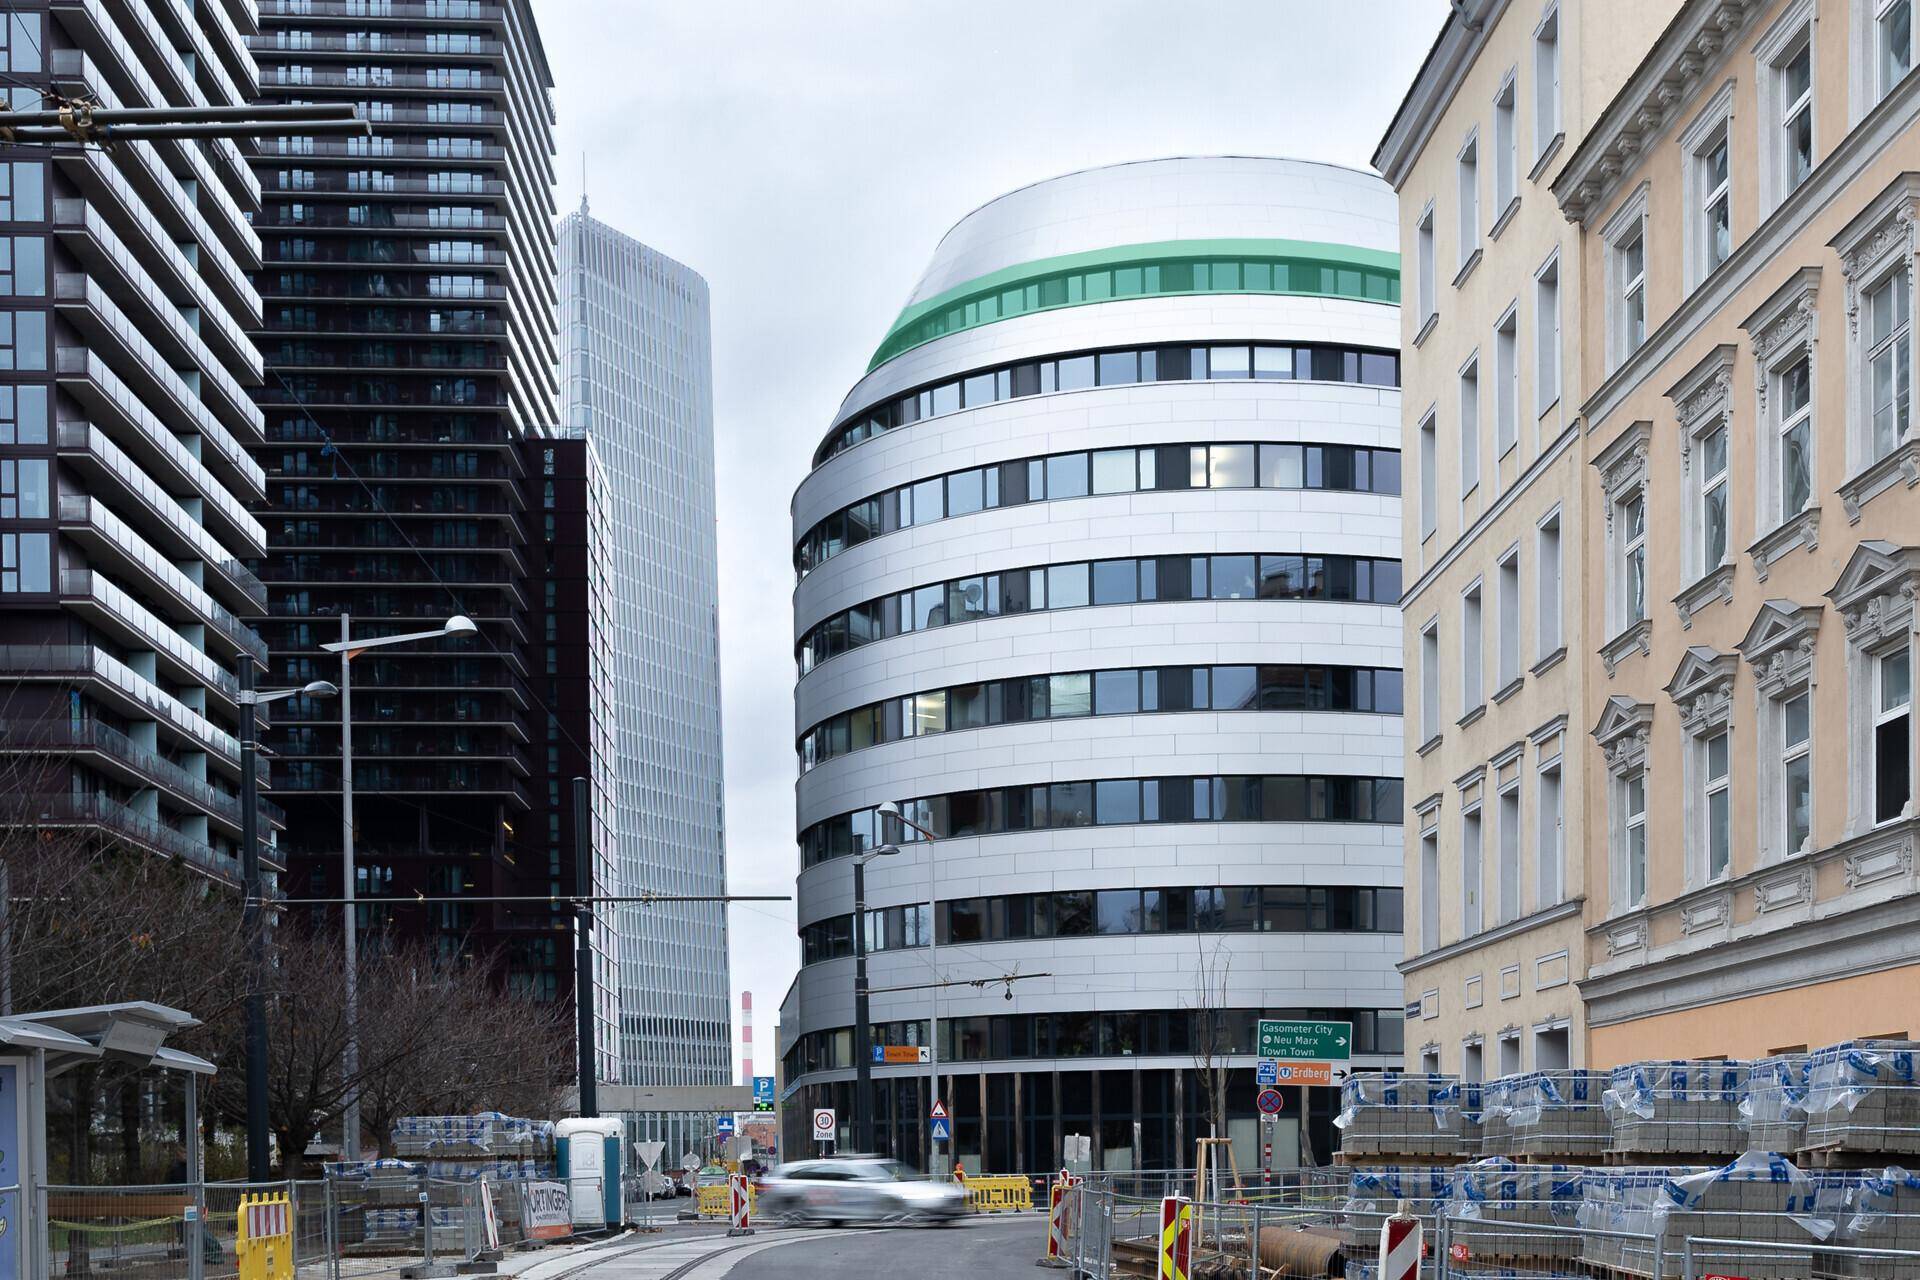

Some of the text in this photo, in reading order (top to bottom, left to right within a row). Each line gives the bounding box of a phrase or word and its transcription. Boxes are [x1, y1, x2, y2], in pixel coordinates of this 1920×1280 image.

[1262, 1024, 1333, 1035] Gasometer City
[1274, 1036, 1292, 1044] Neu
[1295, 1036, 1318, 1045] Marx
[1262, 1046, 1315, 1057] Town Town
[1258, 1065, 1277, 1074] P+R
[1293, 1068, 1329, 1080] Erdberg
[760, 1081, 769, 1092] P
[819, 1116, 829, 1125] 30
[815, 1130, 833, 1139] Zone
